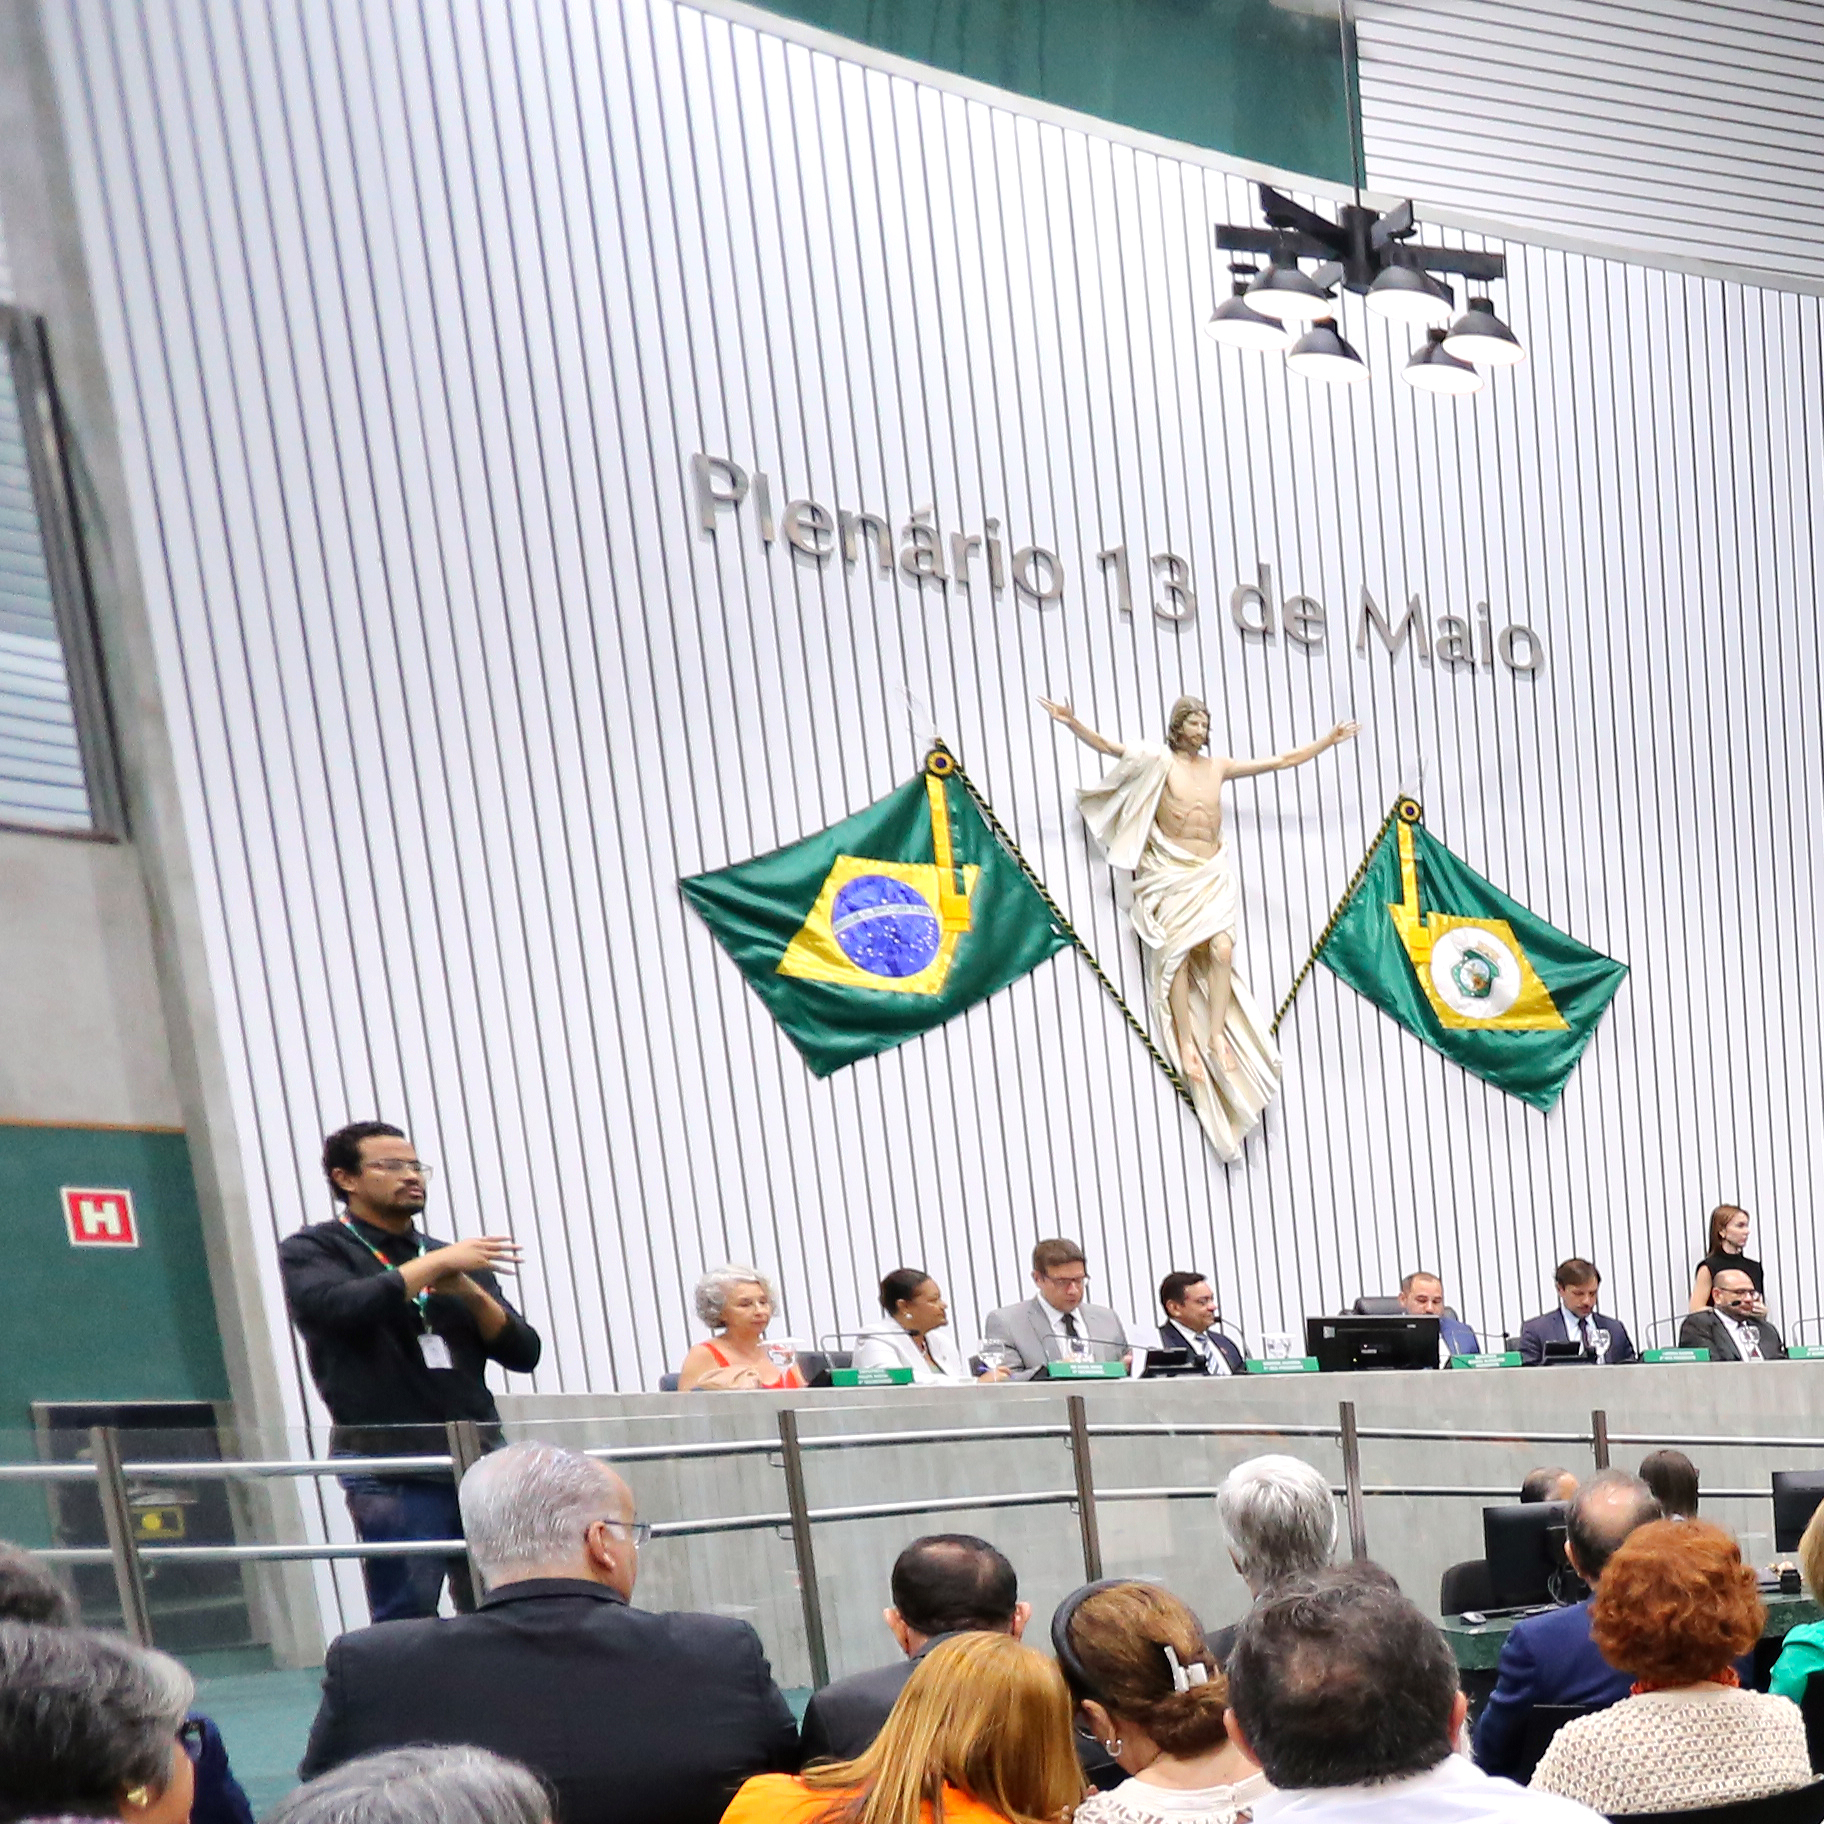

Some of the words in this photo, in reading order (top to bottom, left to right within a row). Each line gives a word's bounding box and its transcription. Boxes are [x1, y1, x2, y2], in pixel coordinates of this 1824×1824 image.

[692, 452, 1066, 601] Plenário
[1098, 545, 1196, 624] 13
[1230, 562, 1327, 648] de
[1355, 583, 1547, 680] Maio
